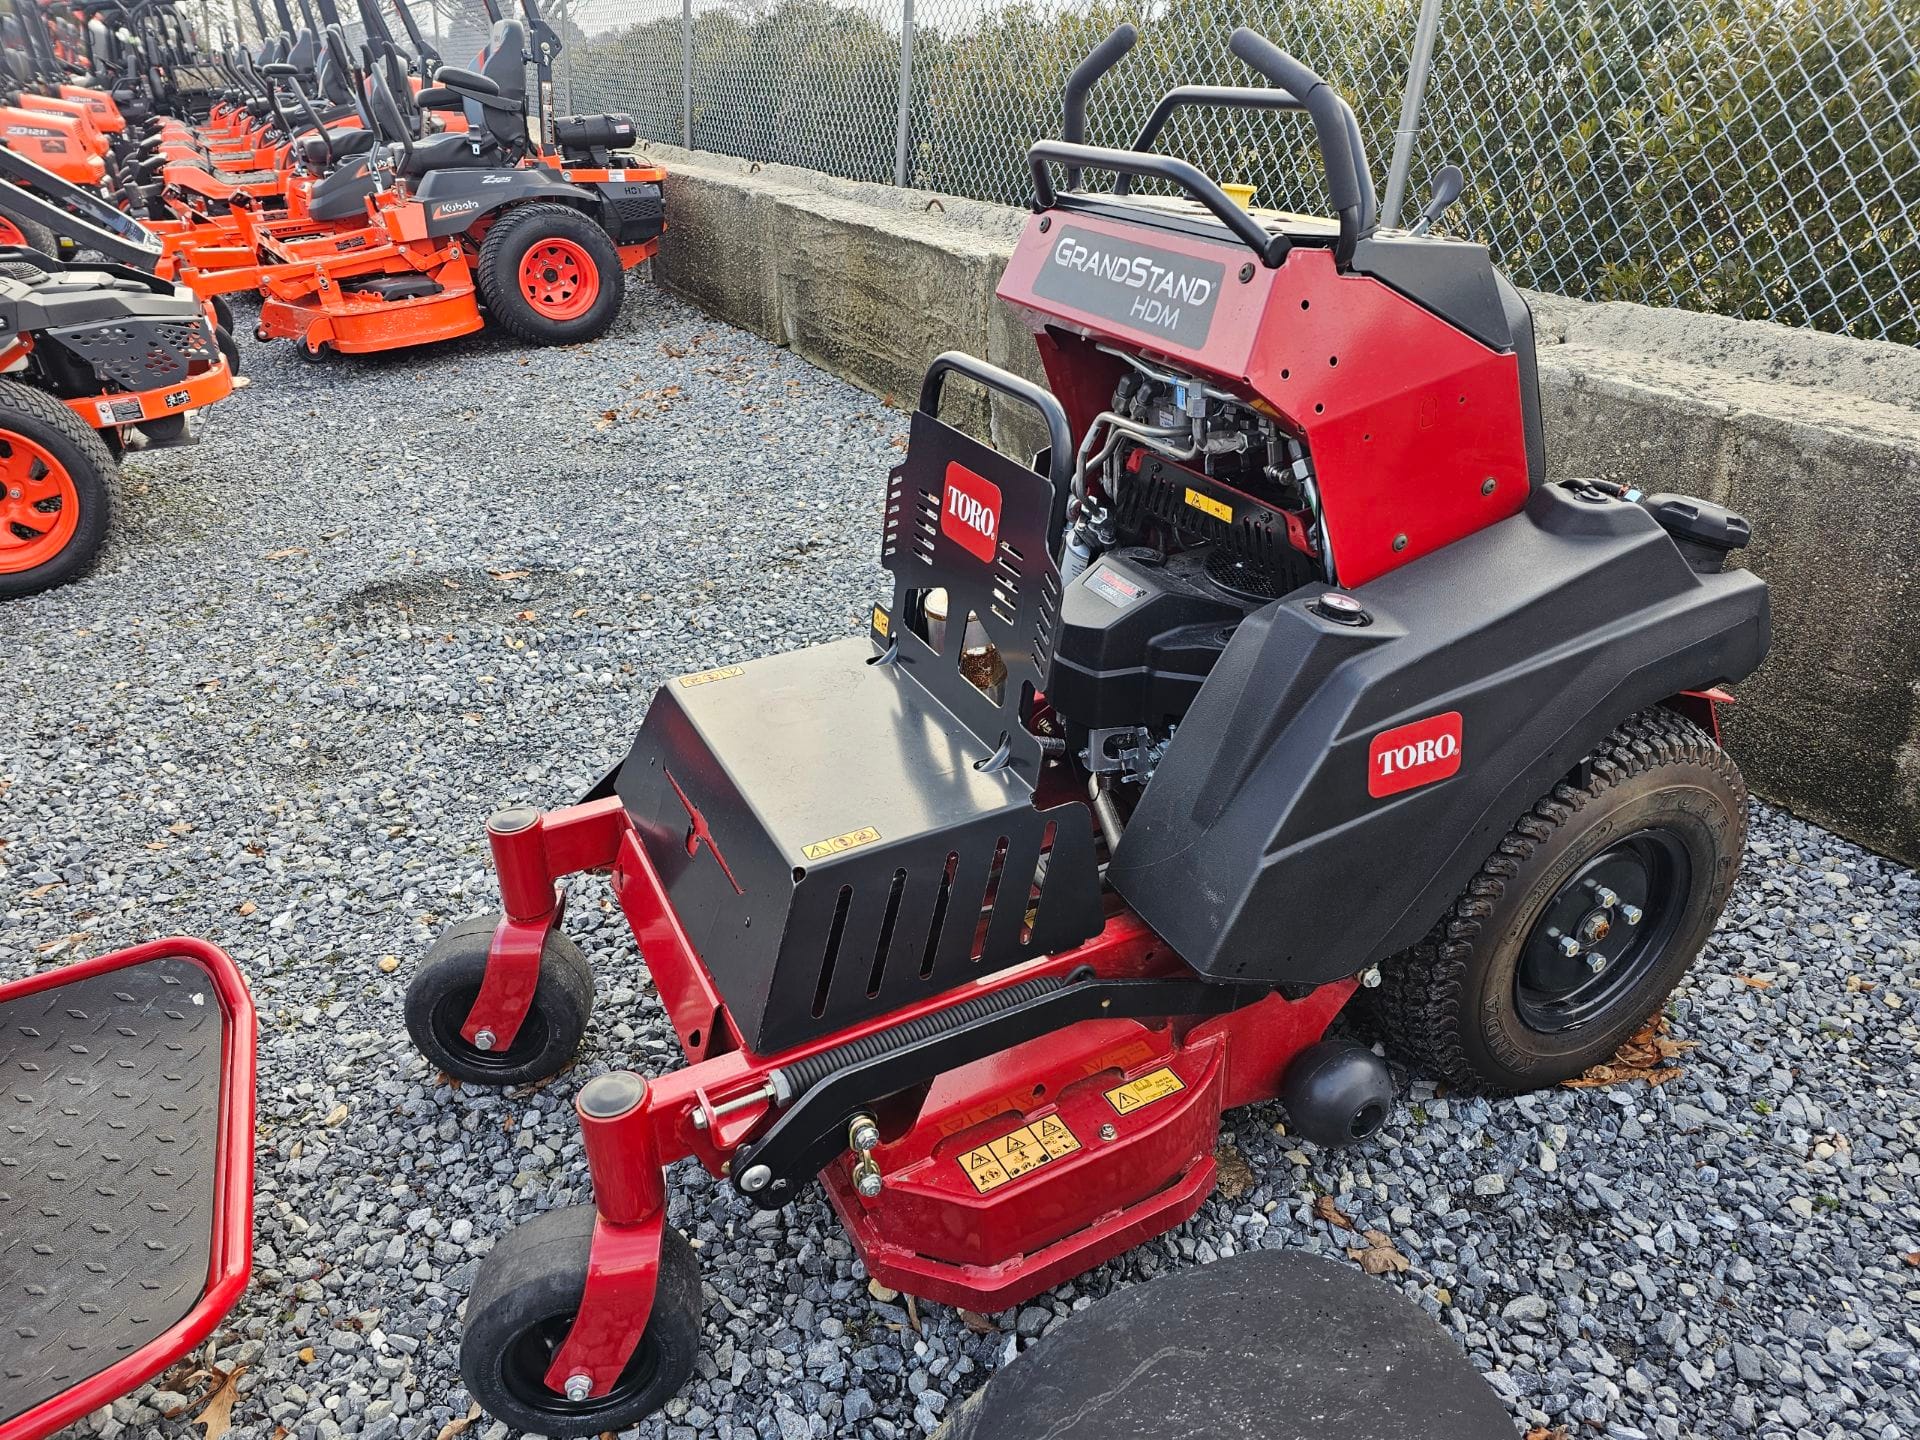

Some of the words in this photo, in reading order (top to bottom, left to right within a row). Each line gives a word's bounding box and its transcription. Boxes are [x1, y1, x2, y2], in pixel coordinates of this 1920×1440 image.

[442, 200, 480, 213] Kubota
[1130, 295, 1181, 330] HDM
[947, 485, 996, 537] TORO
[1377, 733, 1456, 776] TORO
[1482, 992, 1537, 1074] KENDA
